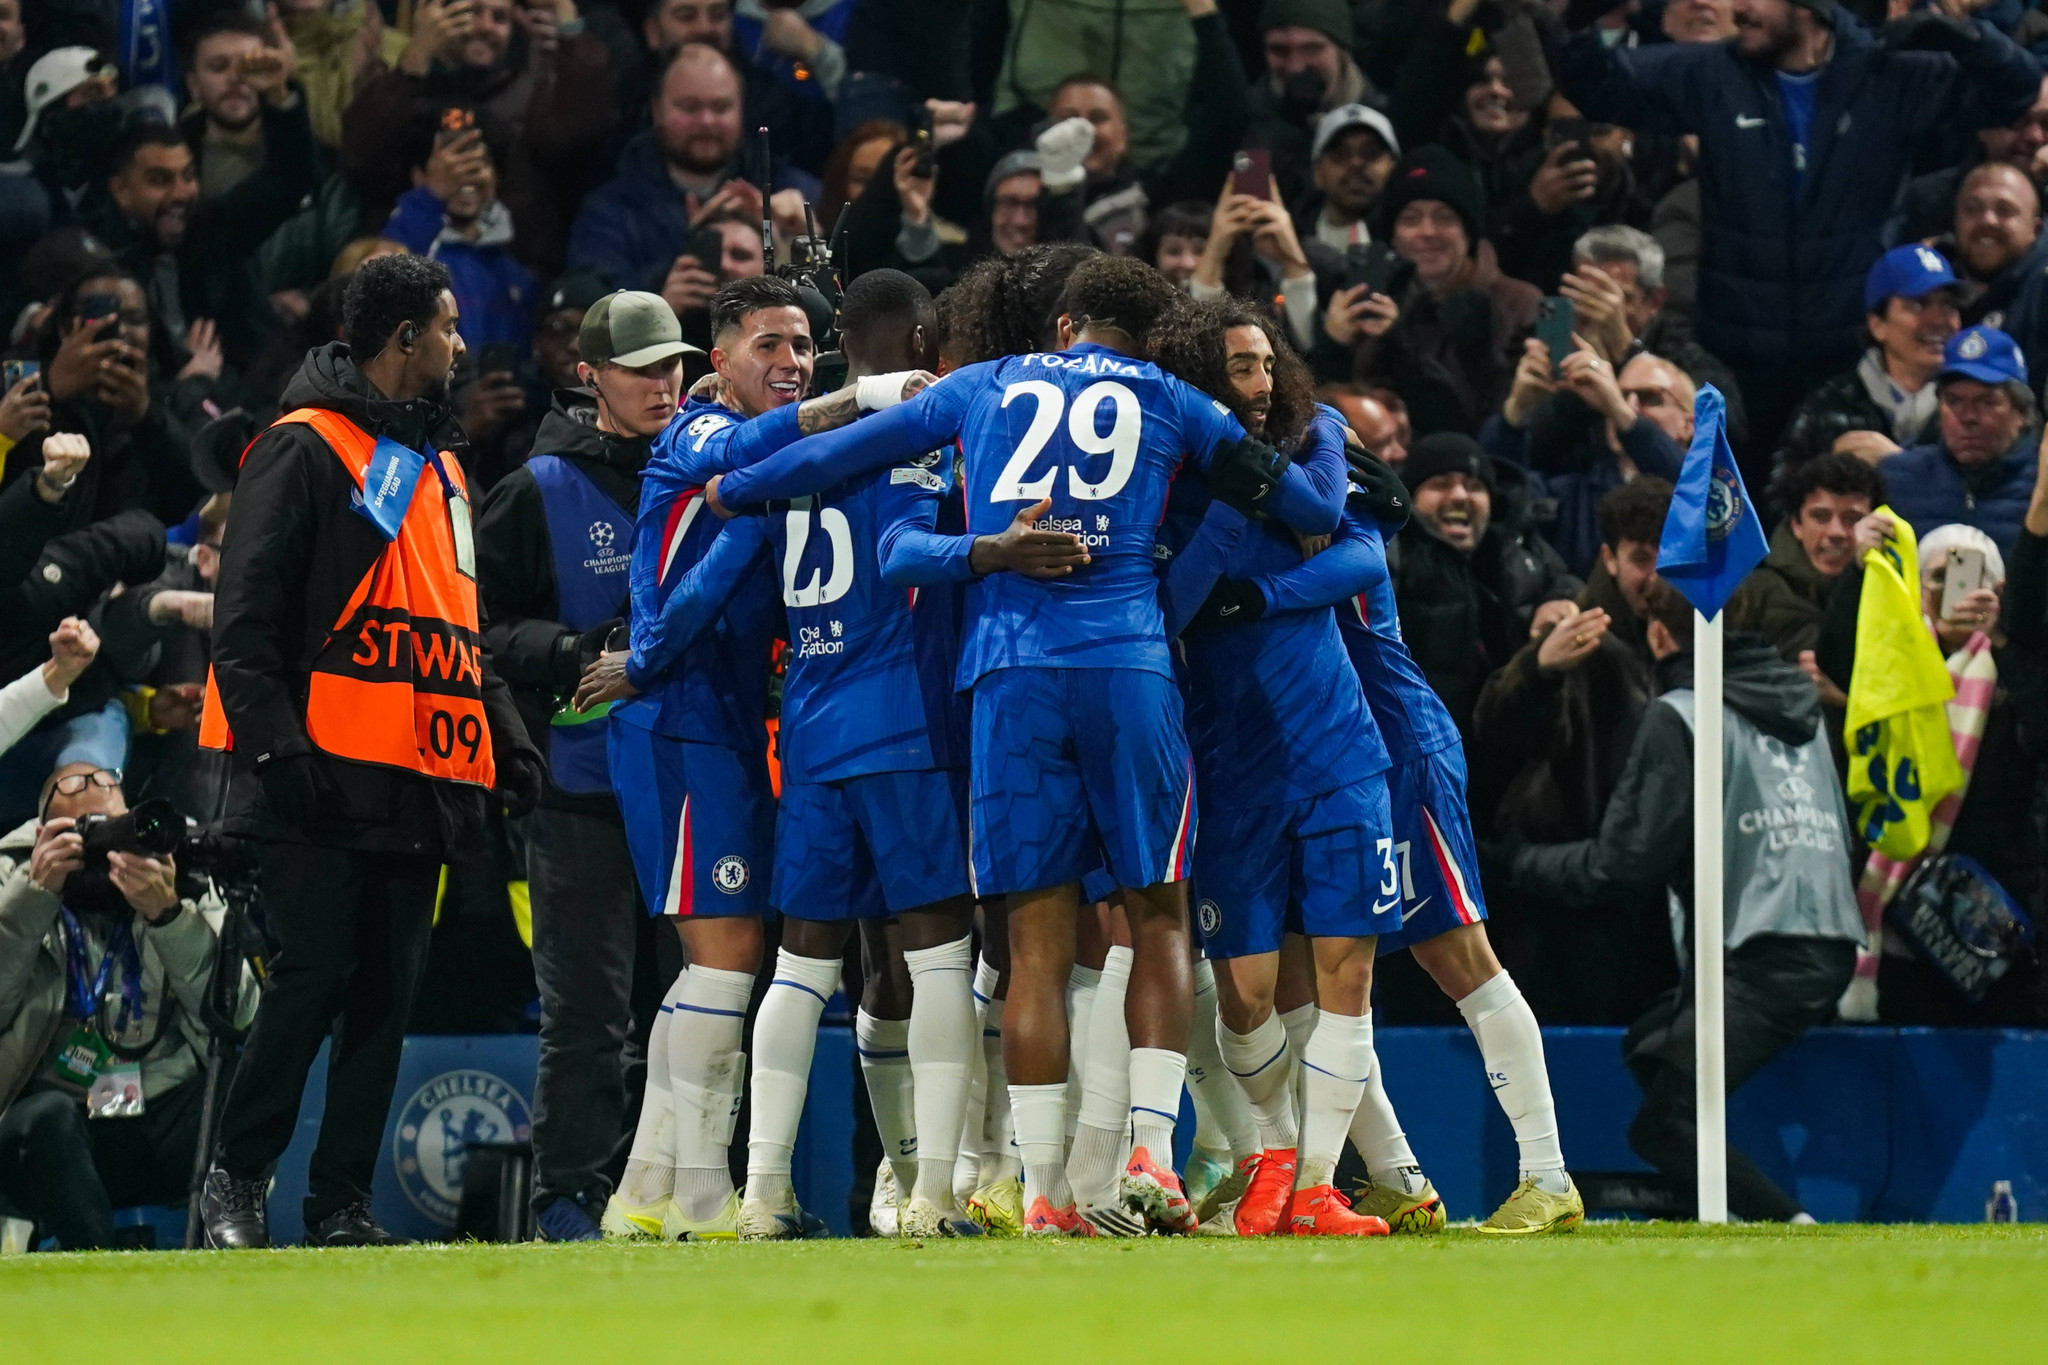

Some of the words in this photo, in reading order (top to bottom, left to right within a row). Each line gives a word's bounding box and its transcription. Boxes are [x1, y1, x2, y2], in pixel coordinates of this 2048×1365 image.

[990, 379, 1142, 503] 29
[374, 455, 400, 509] SAFEGUARDING
[388, 475, 401, 497] LEAD
[1032, 515, 1083, 531] elsea
[594, 562, 627, 575] LEAGUE
[1376, 837, 1398, 896] 3
[1488, 1072, 1508, 1081] FC
[419, 1075, 511, 1110] CHELSEA
